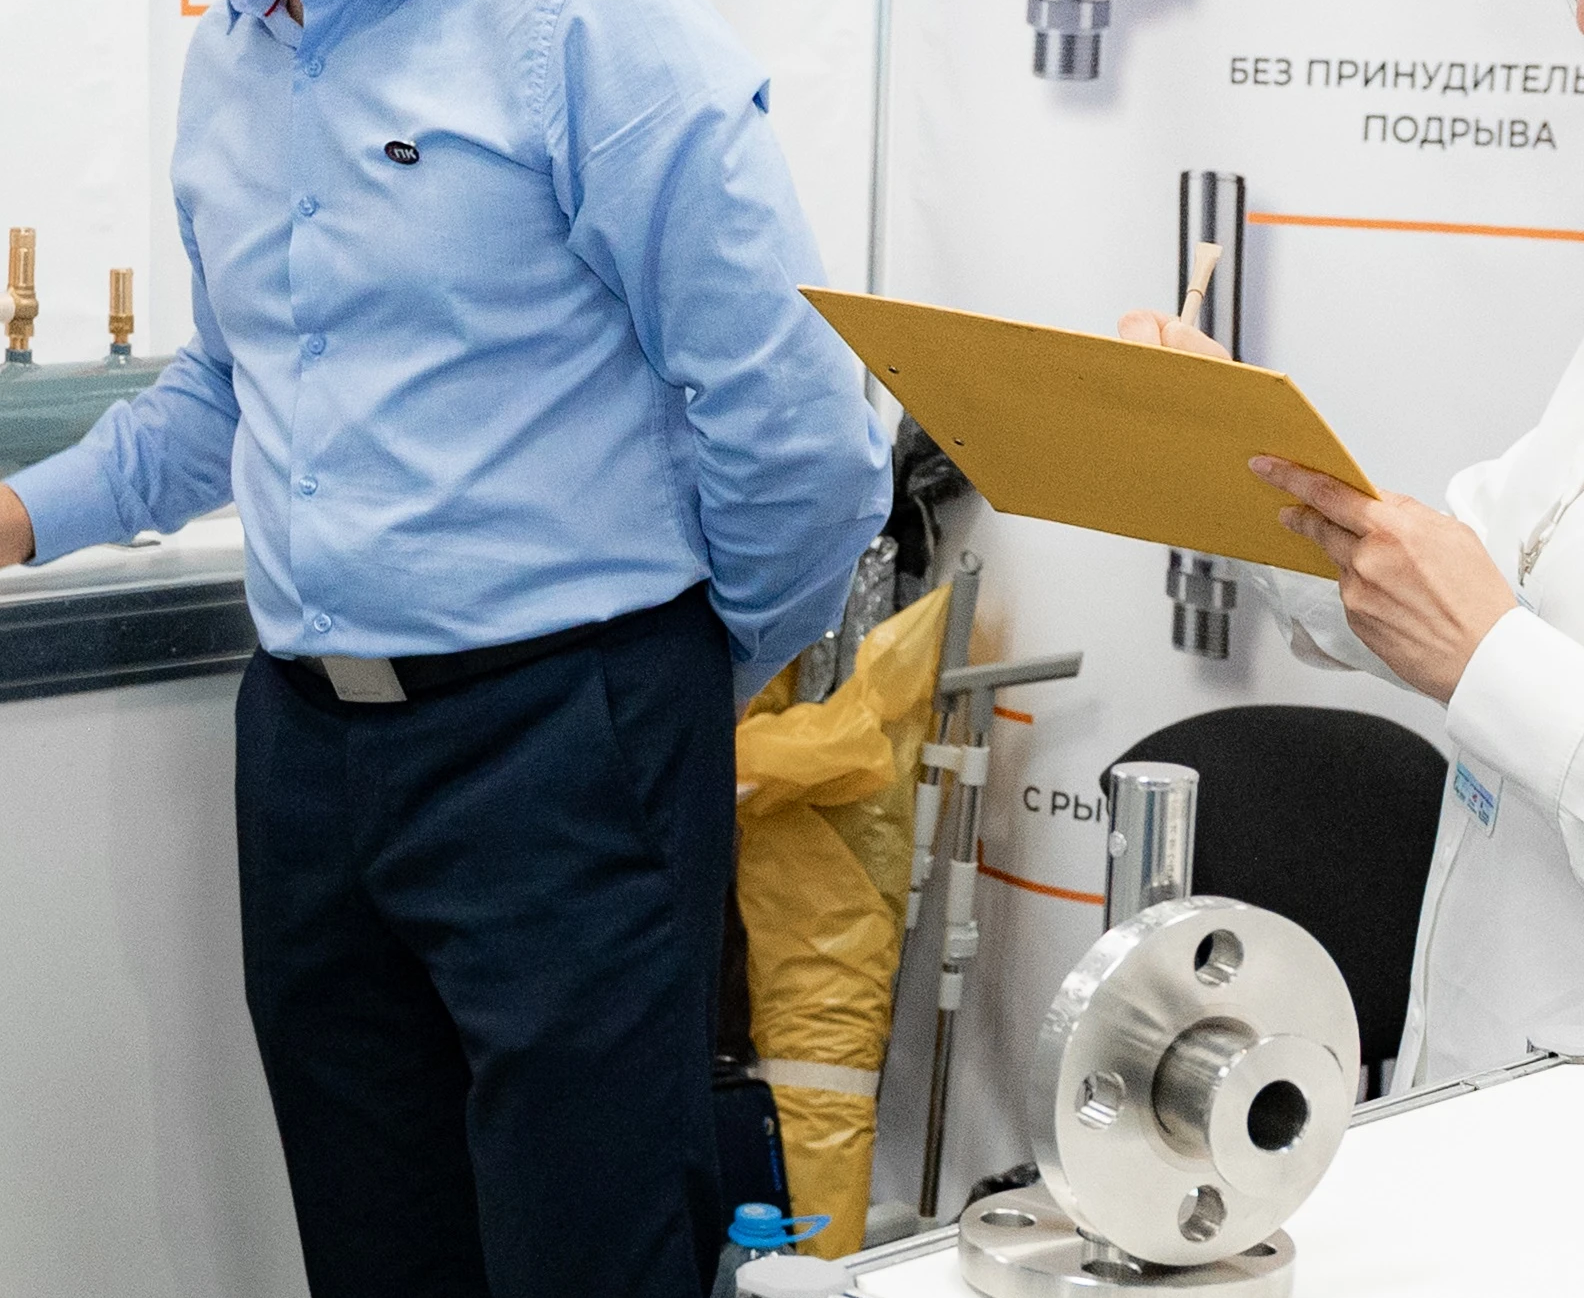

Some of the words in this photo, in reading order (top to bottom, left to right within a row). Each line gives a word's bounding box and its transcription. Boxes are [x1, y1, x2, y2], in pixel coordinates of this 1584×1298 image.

[1230, 56, 1293, 87] БЕЗ
[1363, 114, 1557, 150] ПОДРЫВА
[1021, 785, 1041, 813] С
